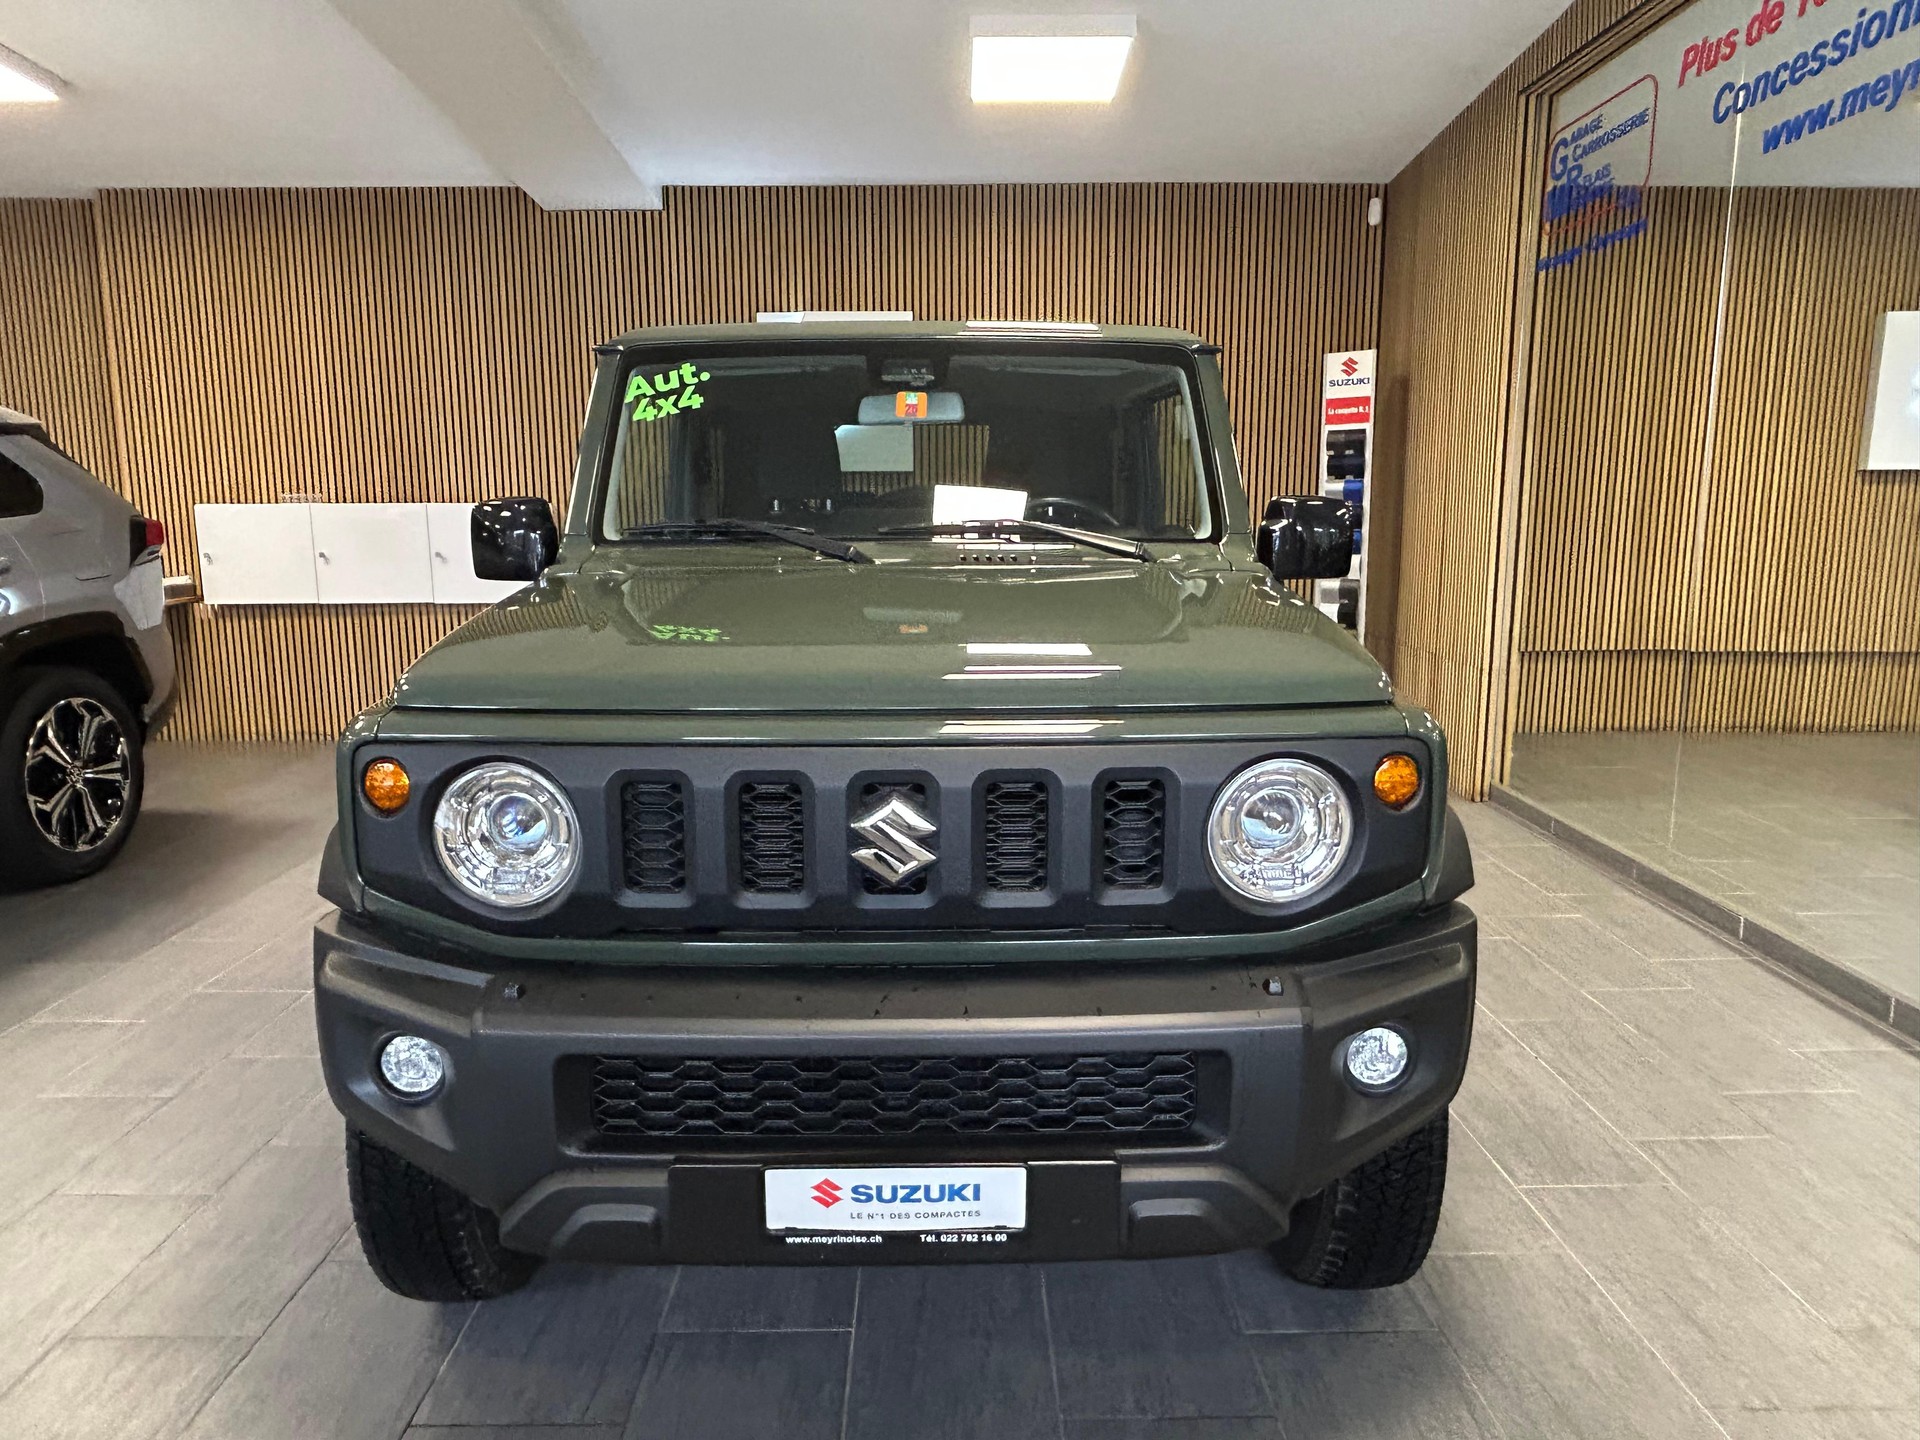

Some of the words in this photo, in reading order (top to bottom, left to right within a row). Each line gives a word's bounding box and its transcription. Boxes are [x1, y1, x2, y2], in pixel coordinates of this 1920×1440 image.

[1677, 27, 1740, 89] Plus
[1745, 0, 1786, 47] de
[624, 362, 711, 404] Aut.
[1328, 377, 1371, 387] SUZUKI
[632, 385, 704, 422] 4x4
[851, 1183, 981, 1204] SUZUKI
[850, 1212, 863, 1220] LE
[889, 1211, 911, 1220] DES
[914, 1210, 981, 1220] COMPACTES
[940, 1233, 959, 1243] 022
[981, 1233, 993, 1243] 16
[994, 1232, 1008, 1243] 00
